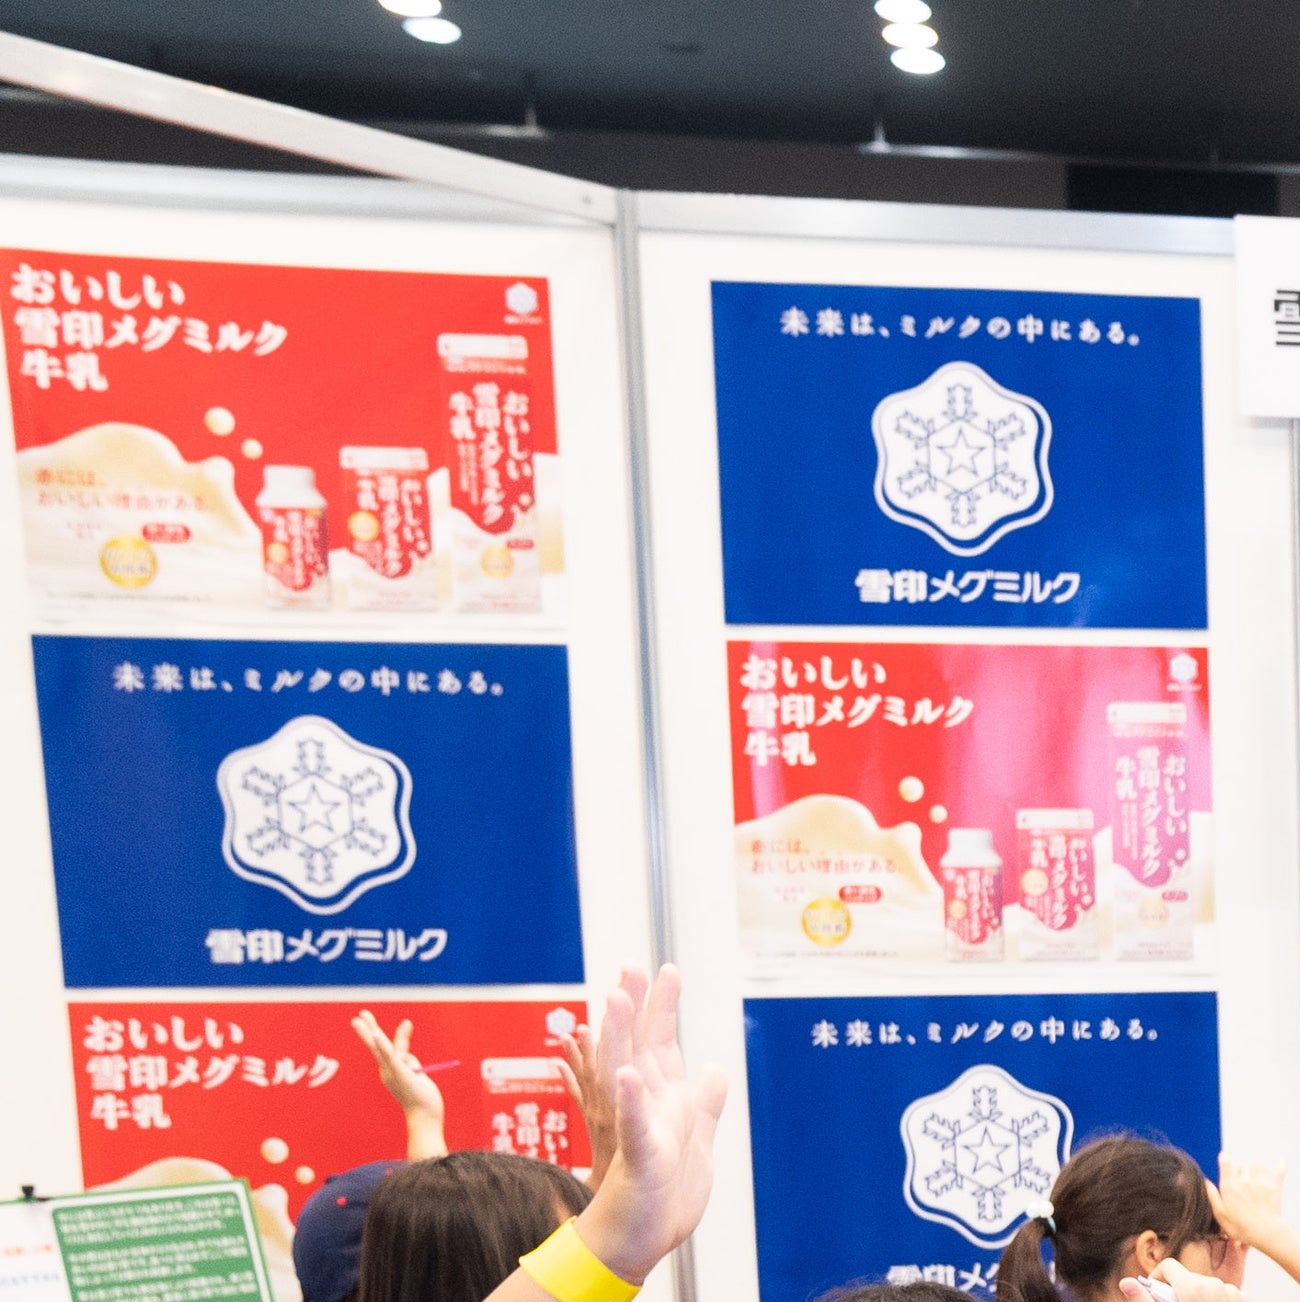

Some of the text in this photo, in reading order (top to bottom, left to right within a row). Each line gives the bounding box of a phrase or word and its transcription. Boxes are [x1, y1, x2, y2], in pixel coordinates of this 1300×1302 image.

[10, 262, 187, 311] おいしい
[13, 305, 289, 357] 雪印メグミルク
[779, 305, 1141, 346] 未来は、ミルクの中にある。
[20, 347, 109, 392] 牛乳
[854, 568, 1081, 605] 雪印メグミルク
[113, 660, 505, 697] 未来は、ミルクの中にある。
[740, 655, 887, 690] おいしい
[740, 694, 975, 728] 雪印メグミルク
[743, 731, 817, 767] 牛乳
[205, 926, 448, 965] 雪印メグミルク
[83, 1014, 244, 1054] おいしい
[811, 1016, 1160, 1049] 未来は、ミルクの中にある。
[86, 1052, 341, 1092] 雪印メグミルク
[90, 1093, 171, 1131] 牛乳
